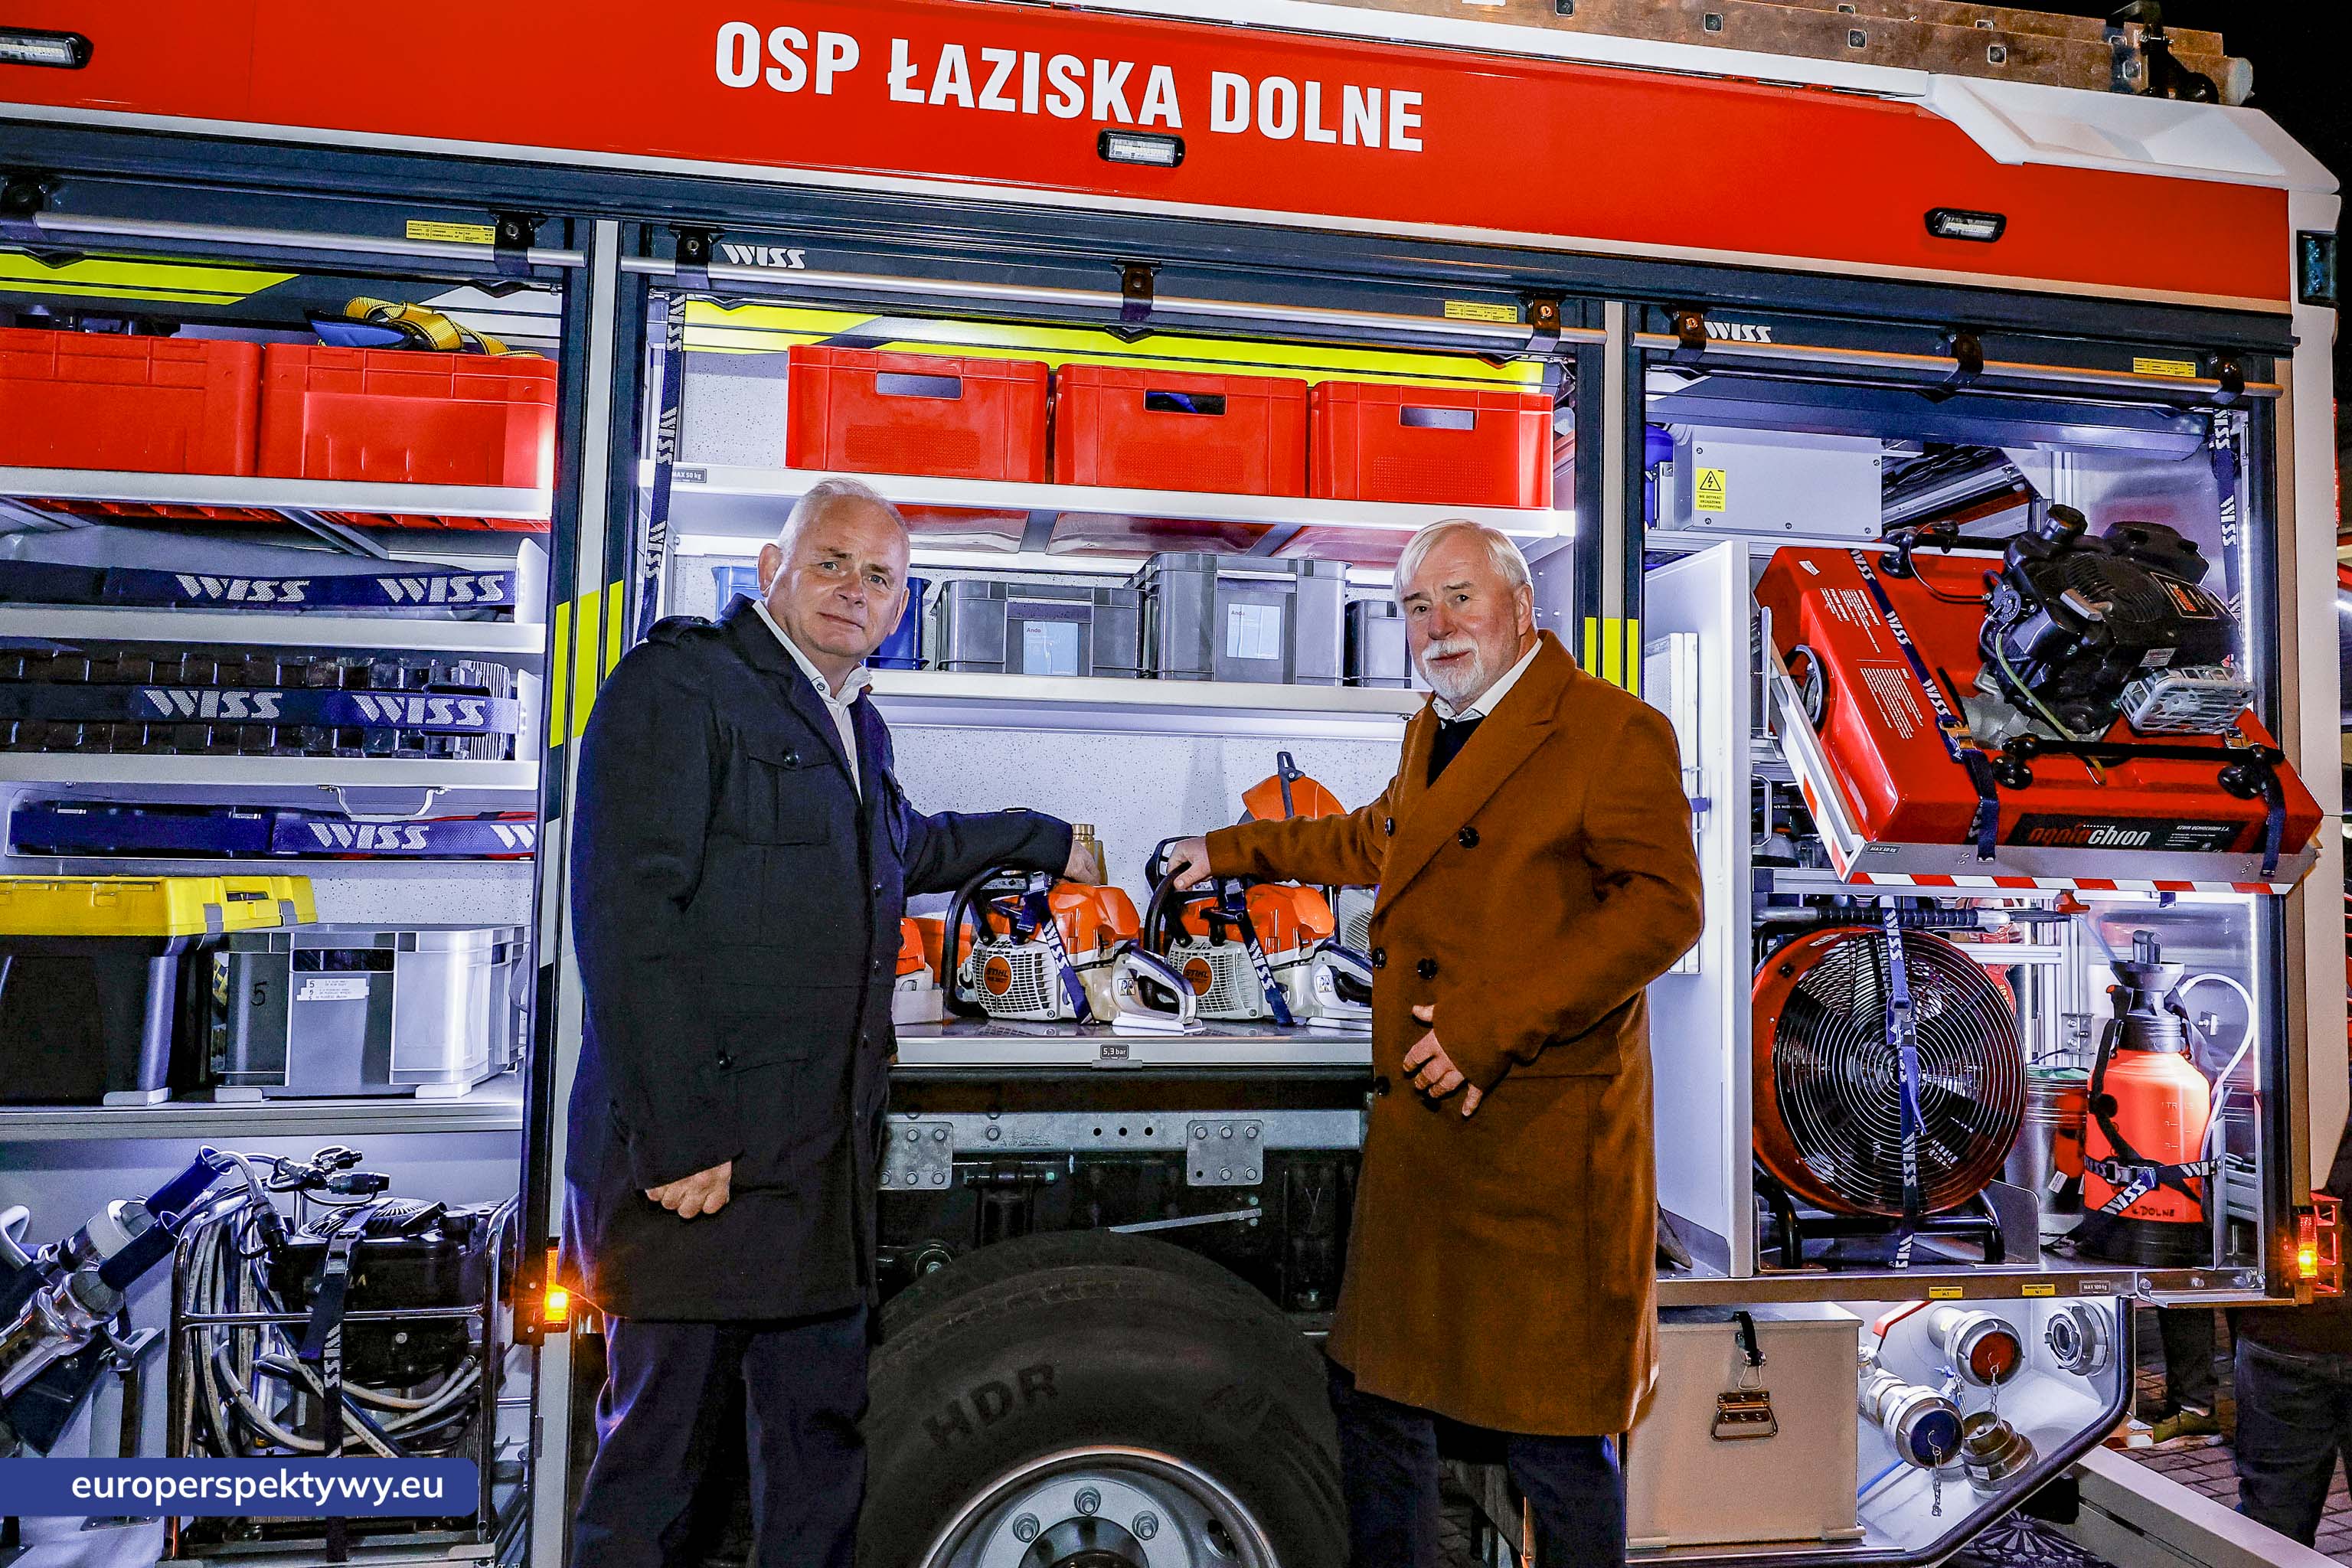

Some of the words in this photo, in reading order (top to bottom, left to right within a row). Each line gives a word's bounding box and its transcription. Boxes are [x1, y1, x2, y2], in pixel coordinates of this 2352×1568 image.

[715, 21, 860, 95] OSP
[887, 38, 1183, 129] ŁAZISKA
[1210, 70, 1424, 152] DOLNE
[721, 244, 806, 270] WISS
[667, 294, 686, 352] WISS
[1704, 322, 1772, 345] WISS
[657, 407, 678, 466] WISS
[2220, 495, 2237, 547] WISS
[645, 520, 668, 579] WISS
[175, 574, 310, 603] WISS
[377, 574, 505, 603] WISS
[1886, 611, 1913, 645] WISS
[144, 690, 283, 720] WISS
[352, 694, 485, 727] WISS
[1922, 678, 1952, 716] WISS
[306, 822, 430, 851] WISS
[1044, 918, 1070, 970] WISS
[1886, 909, 1903, 961] WISS
[986, 967, 1009, 978] STIHL
[1185, 969, 1209, 978] STIHL
[1249, 938, 1276, 991] WISS
[251, 981, 268, 1007] 5
[309, 980, 315, 988] 5
[1103, 1047, 1115, 1056] 5,3
[1903, 1132, 1916, 1187] WISS
[2101, 1179, 2148, 1215] WISS
[2140, 1206, 2175, 1217] DOLNE
[324, 1323, 341, 1388] WISS
[923, 1363, 1060, 1450] HDR
